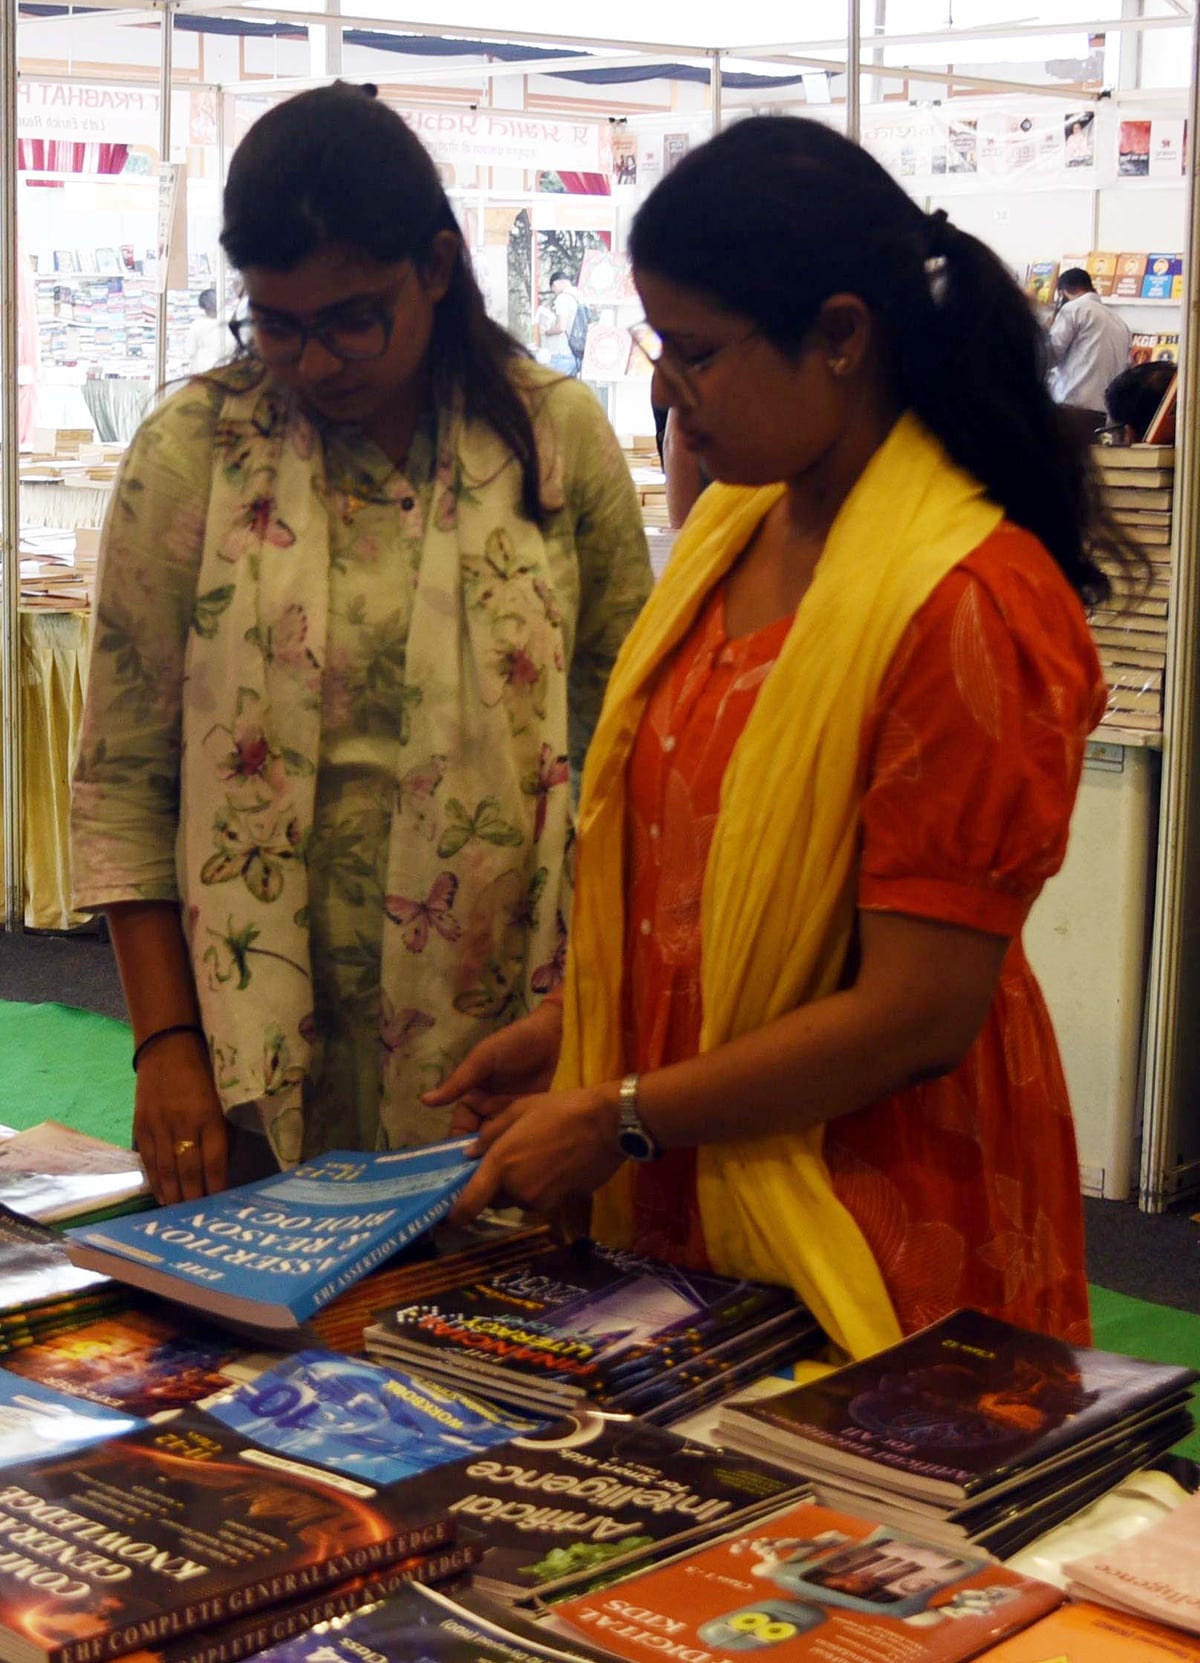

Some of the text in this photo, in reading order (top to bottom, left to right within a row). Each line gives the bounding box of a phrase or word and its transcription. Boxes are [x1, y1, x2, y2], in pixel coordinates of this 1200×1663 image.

[180, 1212, 338, 1253] REASON
[224, 1206, 398, 1232] BIOLOGY
[133, 1219, 349, 1275] ASSERTION
[169, 1260, 226, 1281] EHF
[248, 1384, 320, 1430] 10
[465, 1460, 734, 1522] Intelligence
[448, 1493, 644, 1540] Artificial
[109, 1599, 223, 1652] COMPLETE
[229, 1565, 324, 1610] GENERAL
[326, 1521, 447, 1577] KNOWLEDGE
[577, 1607, 712, 1663] DIGITAL
[602, 1600, 688, 1633] KIDS
